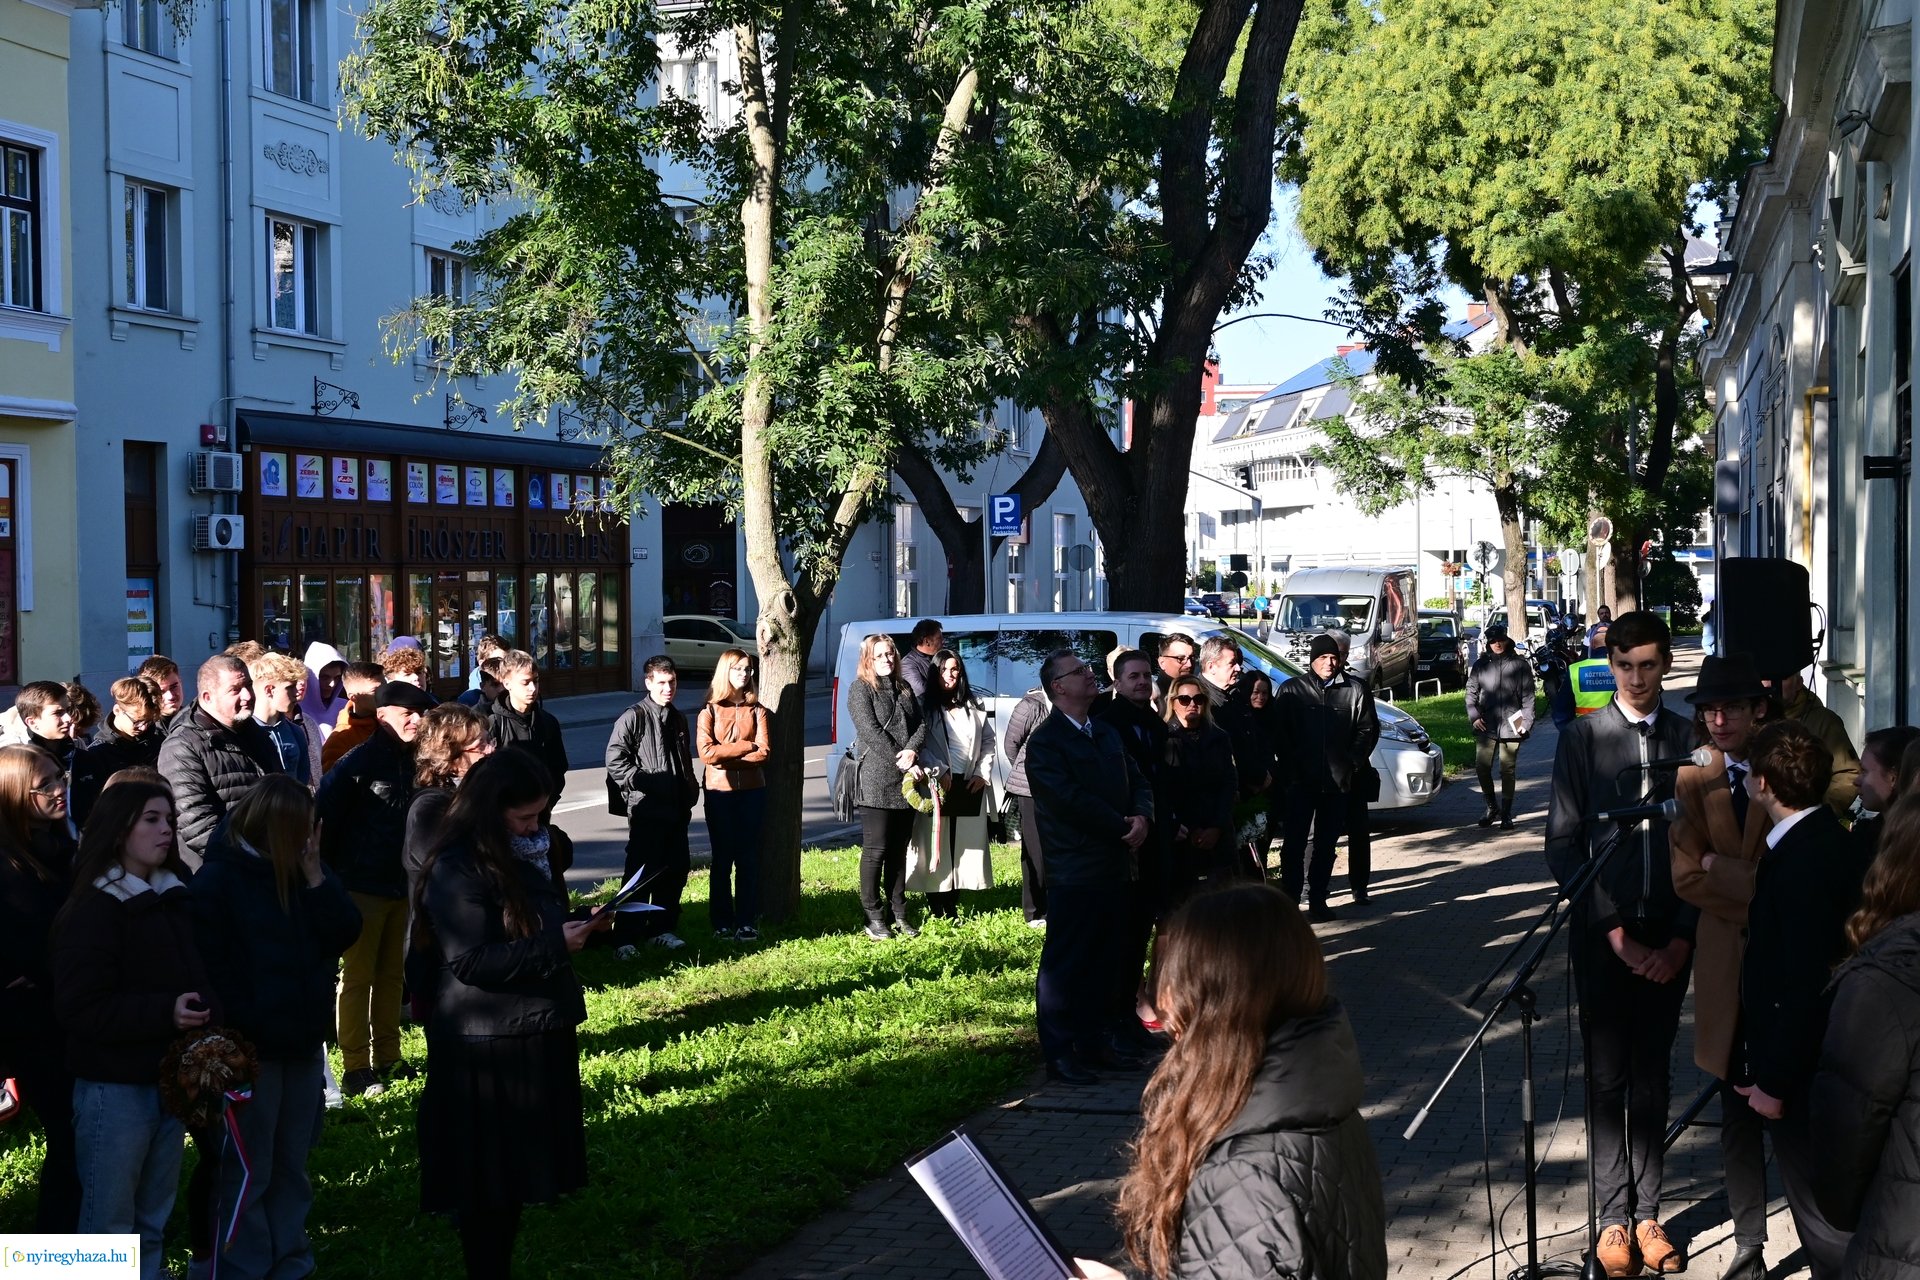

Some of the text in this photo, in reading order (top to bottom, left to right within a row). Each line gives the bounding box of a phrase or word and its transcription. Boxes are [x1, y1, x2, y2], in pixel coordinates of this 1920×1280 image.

[994, 497, 1015, 523] P
[299, 517, 382, 559] PAPÍR
[409, 518, 507, 560] ÍRÓSZER
